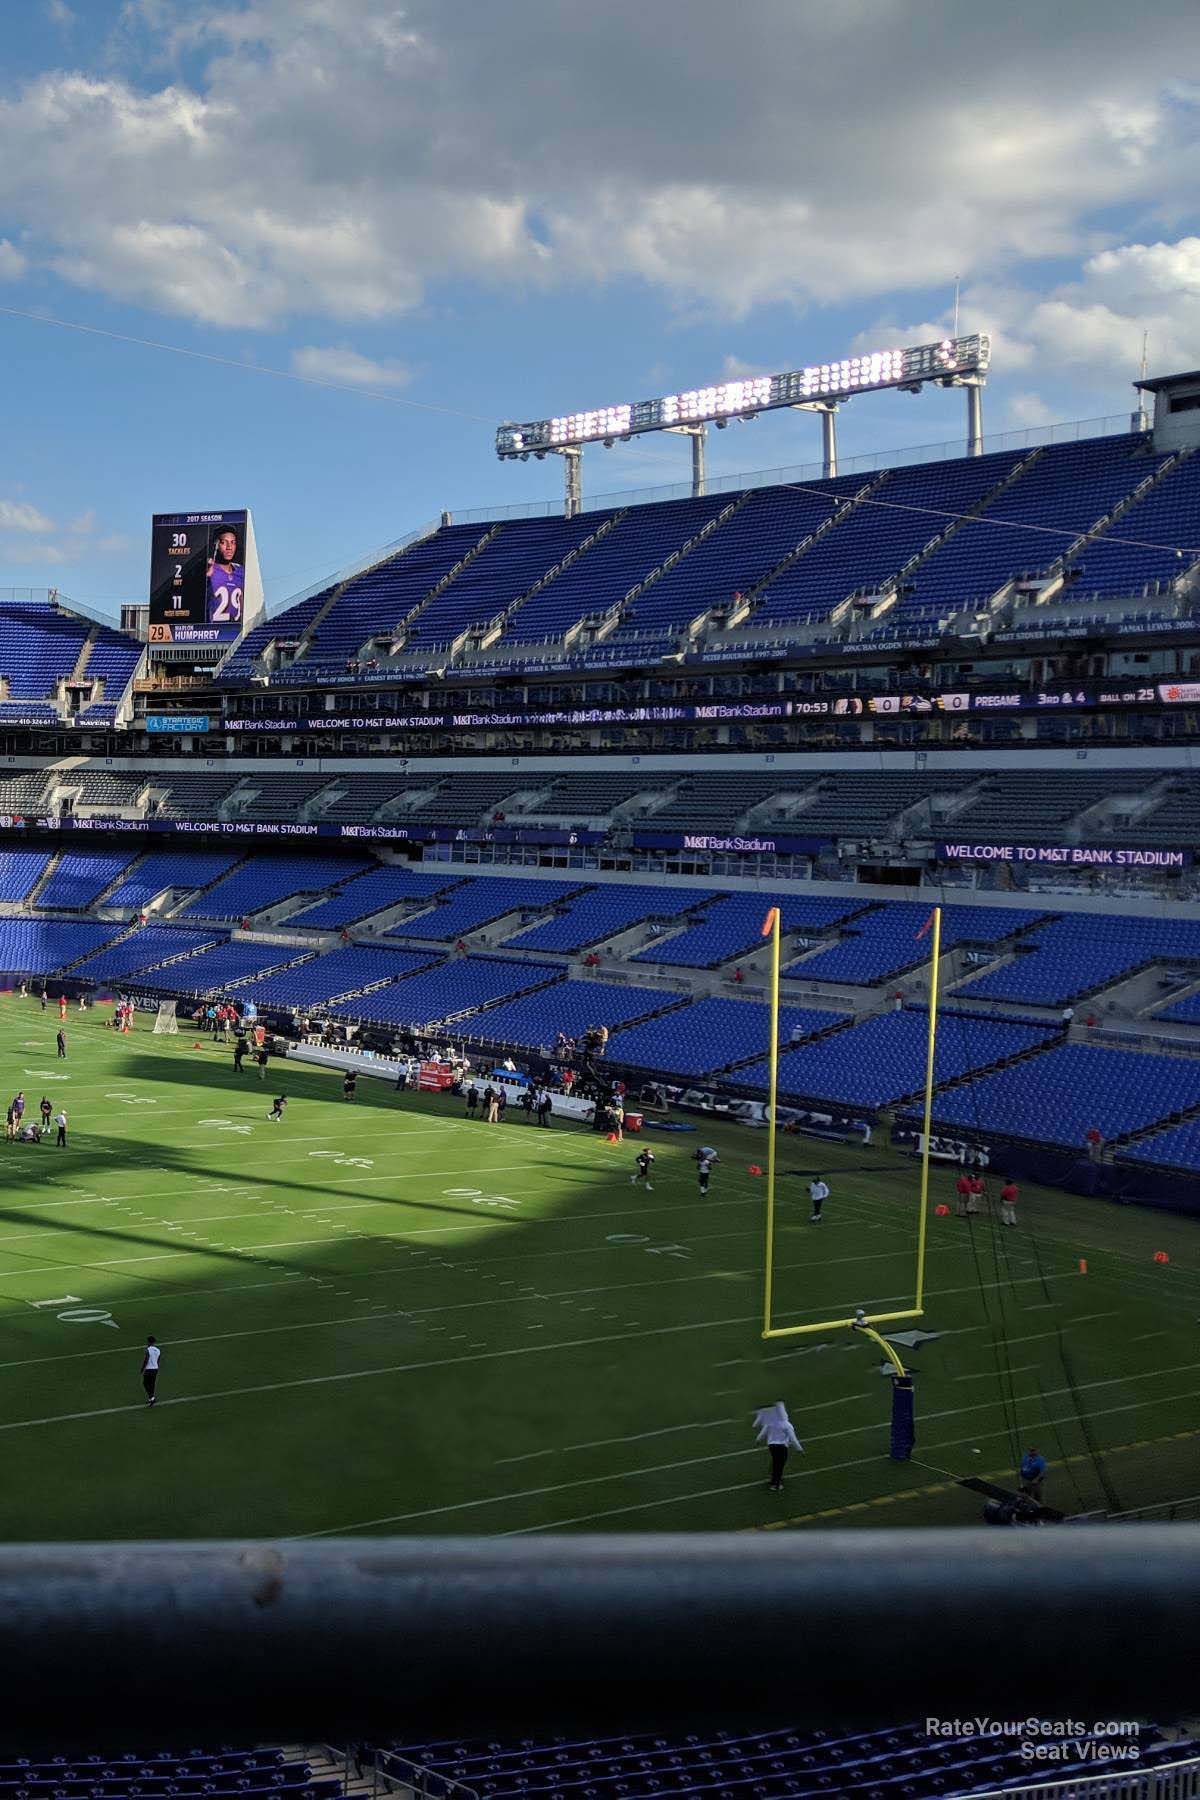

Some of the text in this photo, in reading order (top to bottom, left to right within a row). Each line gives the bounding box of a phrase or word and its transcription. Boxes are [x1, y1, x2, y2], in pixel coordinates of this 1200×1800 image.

[200, 514, 222, 522] SEASON
[172, 533, 187, 547] 30
[175, 565, 182, 578] 2
[172, 596, 182, 609] 11
[212, 586, 242, 622] 29
[151, 625, 164, 640] 29
[174, 630, 220, 640] HUMPHREY
[878, 642, 902, 650] OGDEN
[1037, 691, 1086, 705] 3RD & 4
[1100, 689, 1155, 702] BALL ON 25
[796, 694, 1021, 713] 70:53 0 0 PREGAME
[695, 706, 719, 718] M&T
[719, 705, 743, 717] Bank
[743, 704, 782, 716] Stadium
[225, 719, 297, 729] M&T Bank Stadium
[308, 717, 444, 728] WELCOME TO M&T BANK STADIUM
[453, 715, 472, 725] M&T
[472, 714, 491, 725] Bank
[491, 714, 522, 724] Stadium
[72, 819, 149, 831] M&T Bank Stadium
[176, 822, 318, 834] WELCOME TO M&T BANK STADIUM
[341, 826, 408, 838] M&T Bank Stadium
[684, 836, 775, 851] M&T Bank Stadium
[945, 845, 1183, 866] WELCOME TO M&T BANK STADIUM
[26, 1295, 120, 1329] 10
